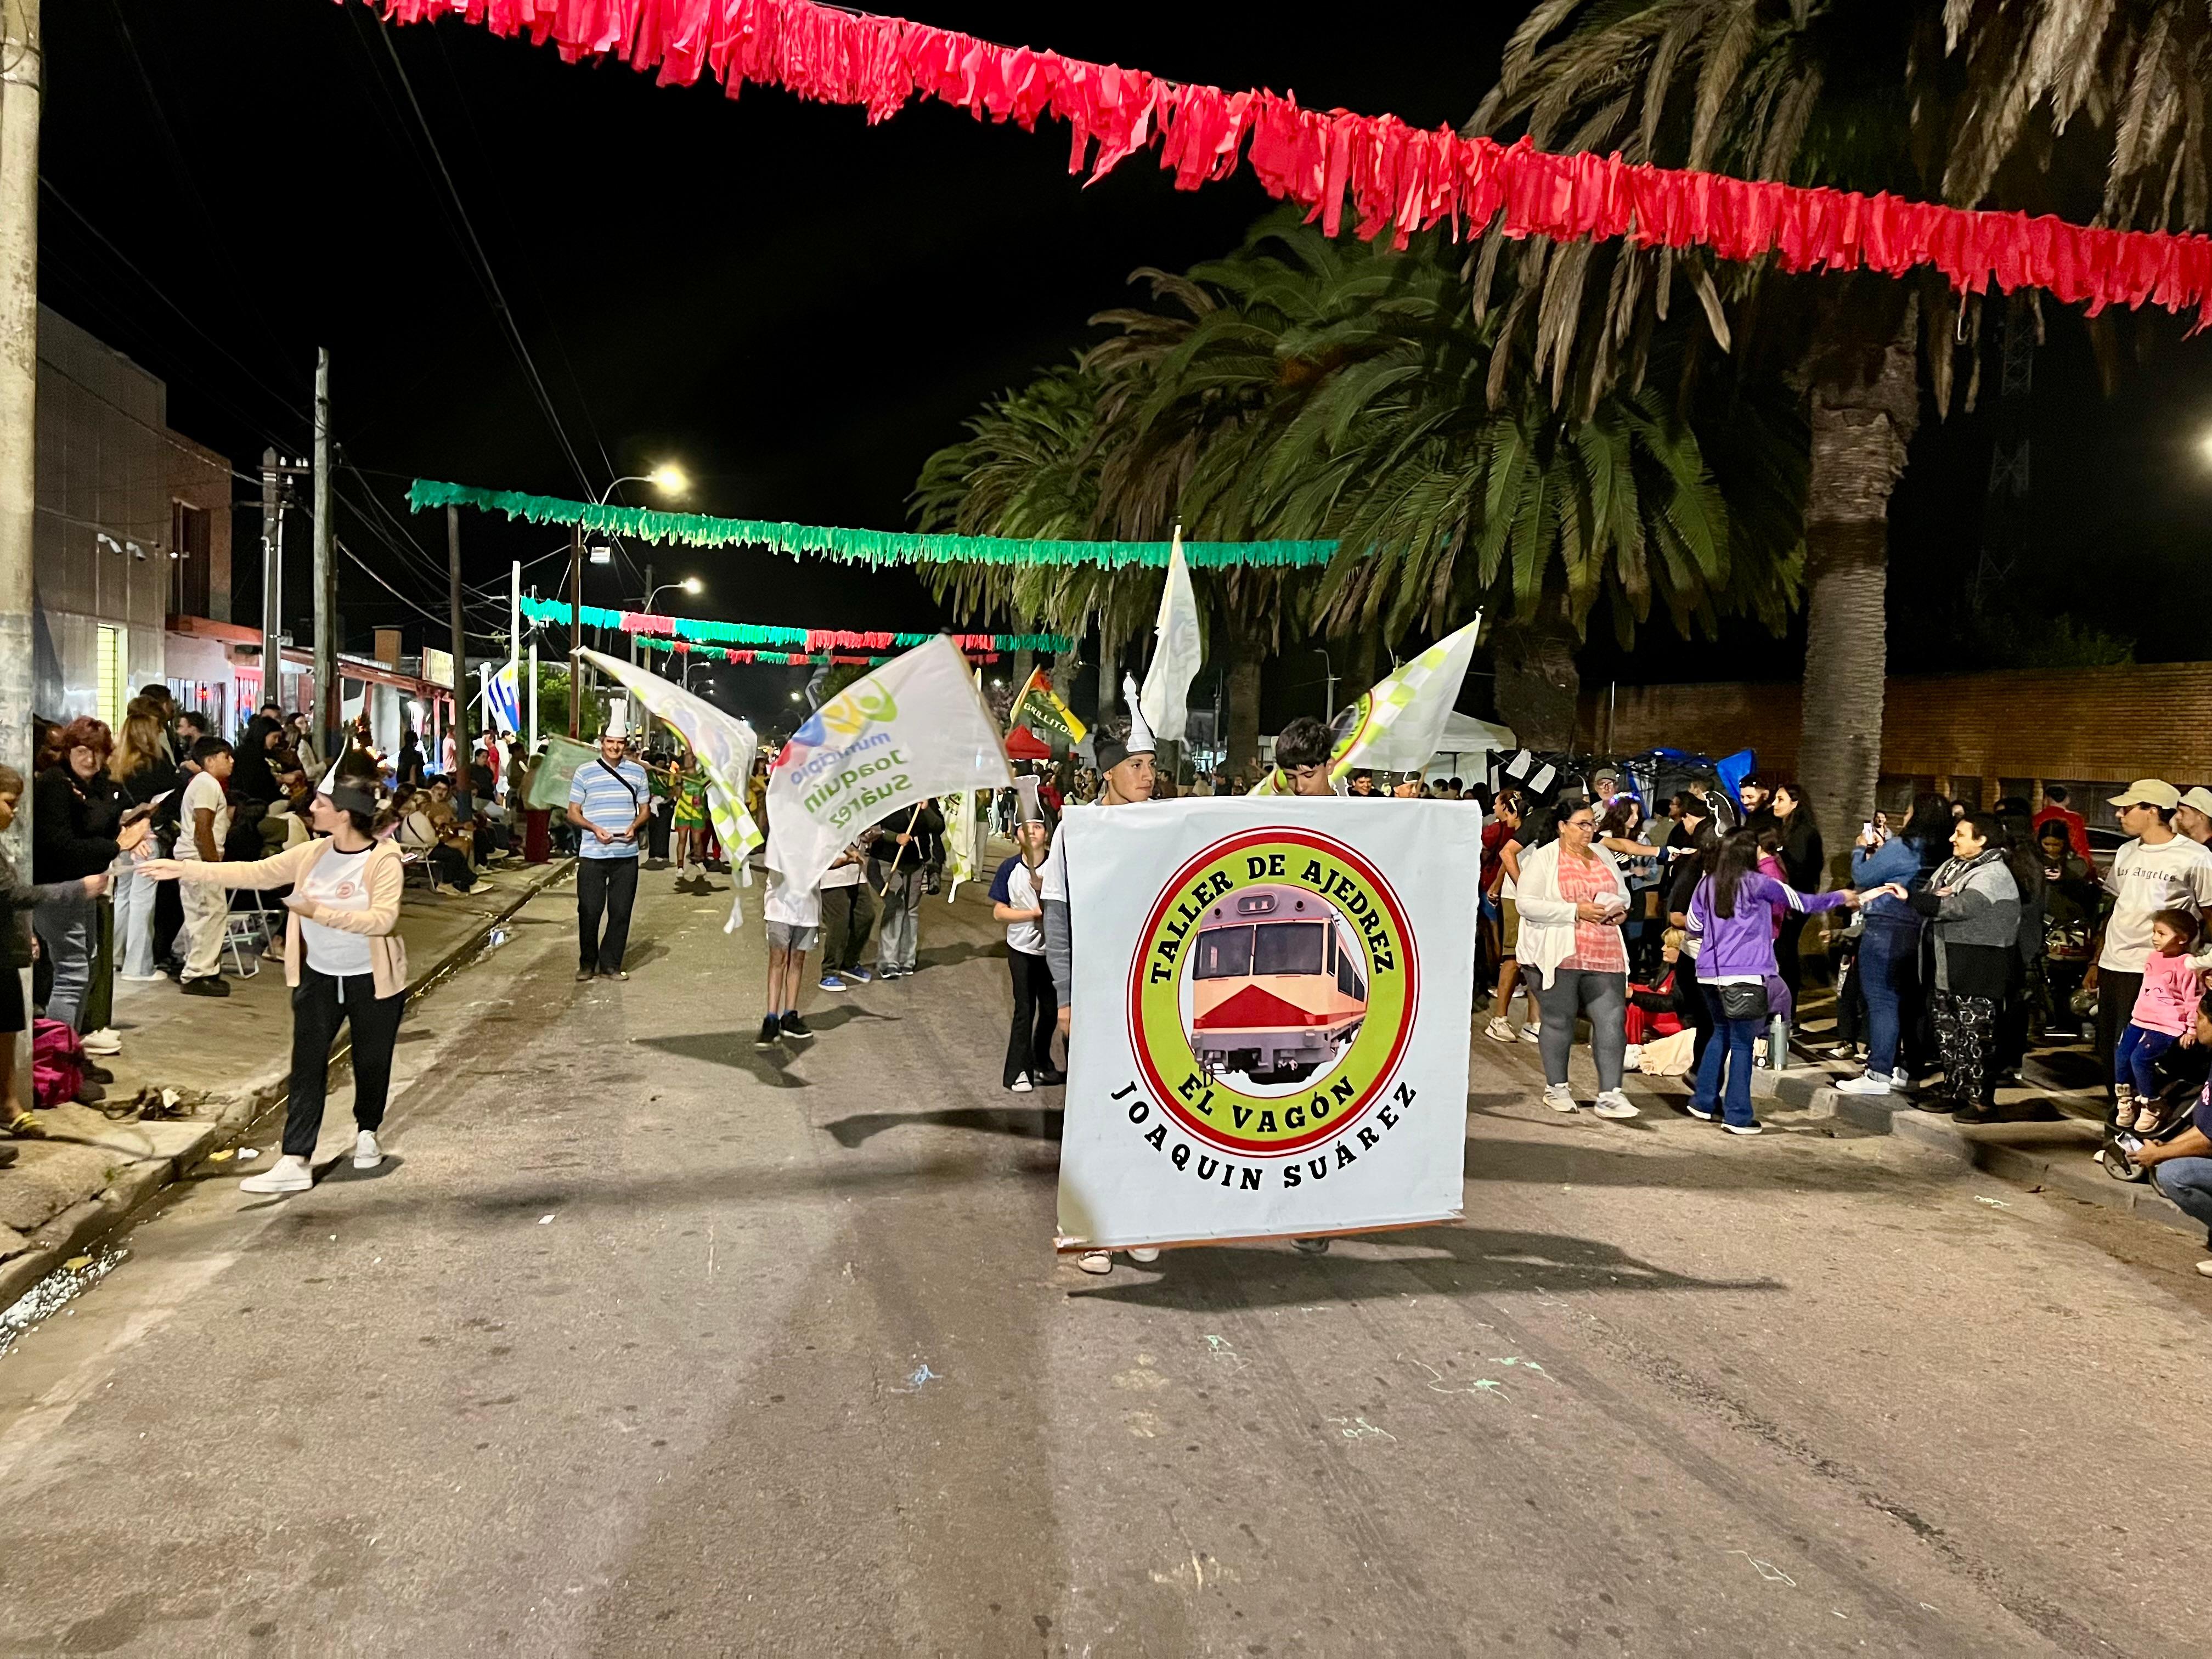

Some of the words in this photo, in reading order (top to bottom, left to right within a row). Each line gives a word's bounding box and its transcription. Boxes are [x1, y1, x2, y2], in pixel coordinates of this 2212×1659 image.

[1150, 871, 1233, 984] TALLER
[1247, 854, 1285, 879] DE
[1301, 860, 1395, 974] AJEDREZ
[1111, 1081, 1263, 1190] JOAQUIN
[1283, 1081, 1417, 1188] SUÁREZ
[1178, 1073, 1214, 1116] EL
[1232, 1076, 1355, 1132] VAGÓN
